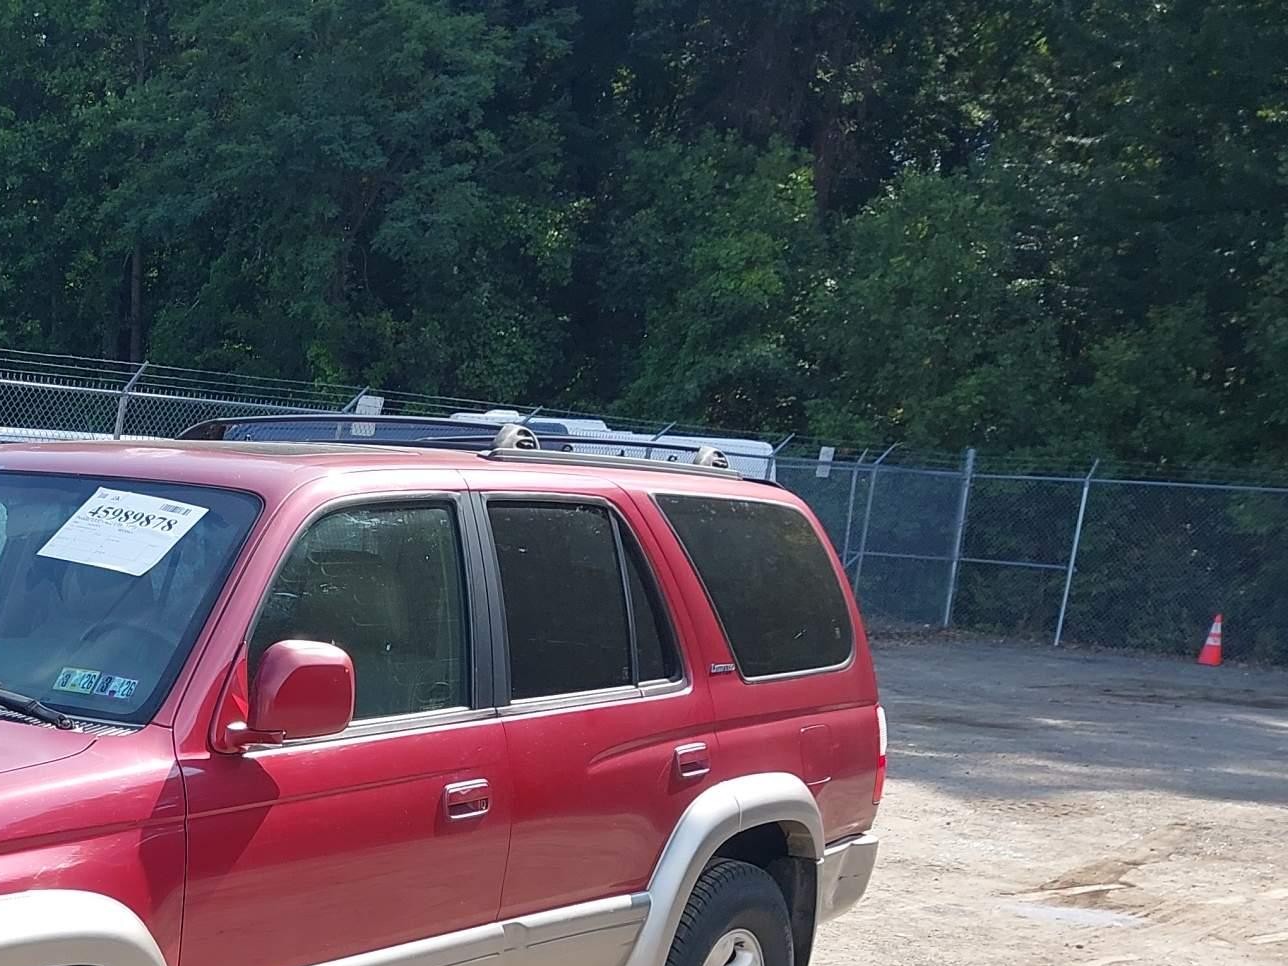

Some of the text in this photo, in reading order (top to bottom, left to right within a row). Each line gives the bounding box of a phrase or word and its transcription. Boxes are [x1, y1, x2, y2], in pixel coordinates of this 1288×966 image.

[89, 504, 178, 532] 45989878
[61, 673, 71, 687] 3
[100, 676, 112, 692] 3
